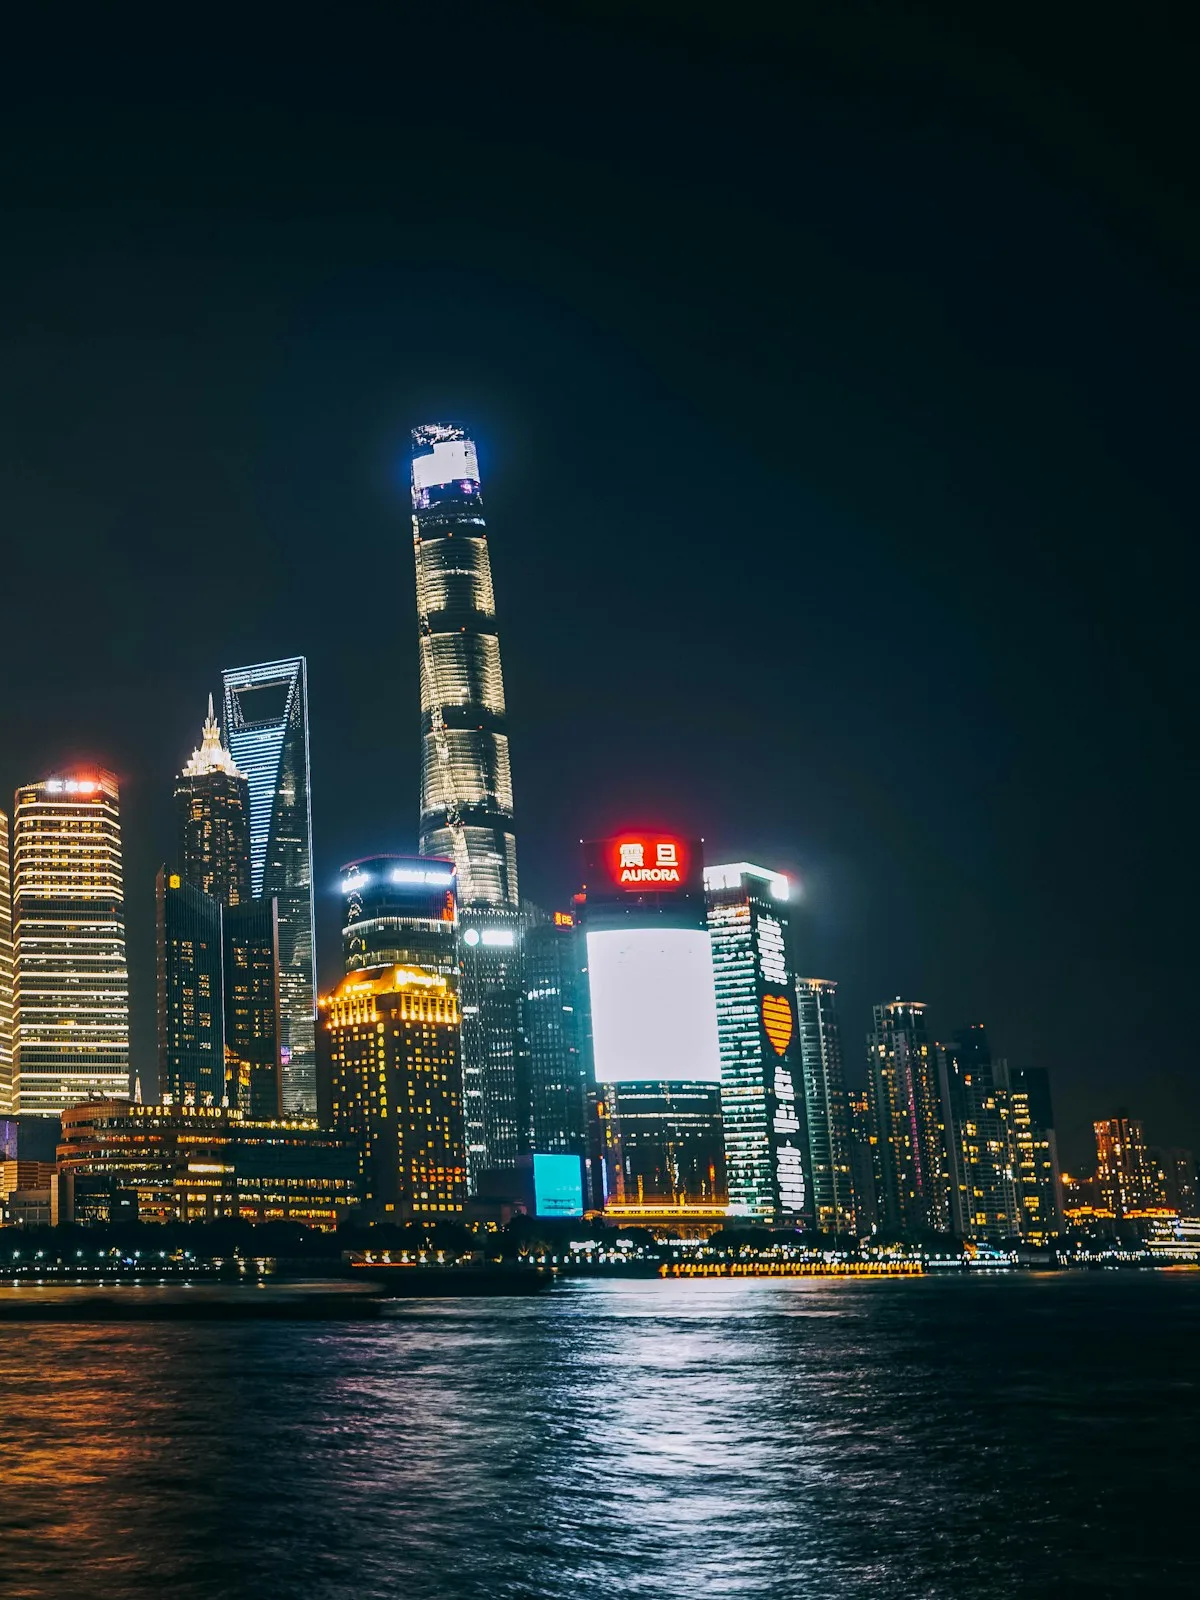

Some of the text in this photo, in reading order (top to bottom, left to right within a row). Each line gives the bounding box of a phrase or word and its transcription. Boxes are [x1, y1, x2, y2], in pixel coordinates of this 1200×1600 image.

[620, 843, 679, 867] 震旦
[621, 868, 680, 882] AURORA
[128, 1106, 172, 1116] SUPER
[181, 1106, 221, 1118] BRAND
